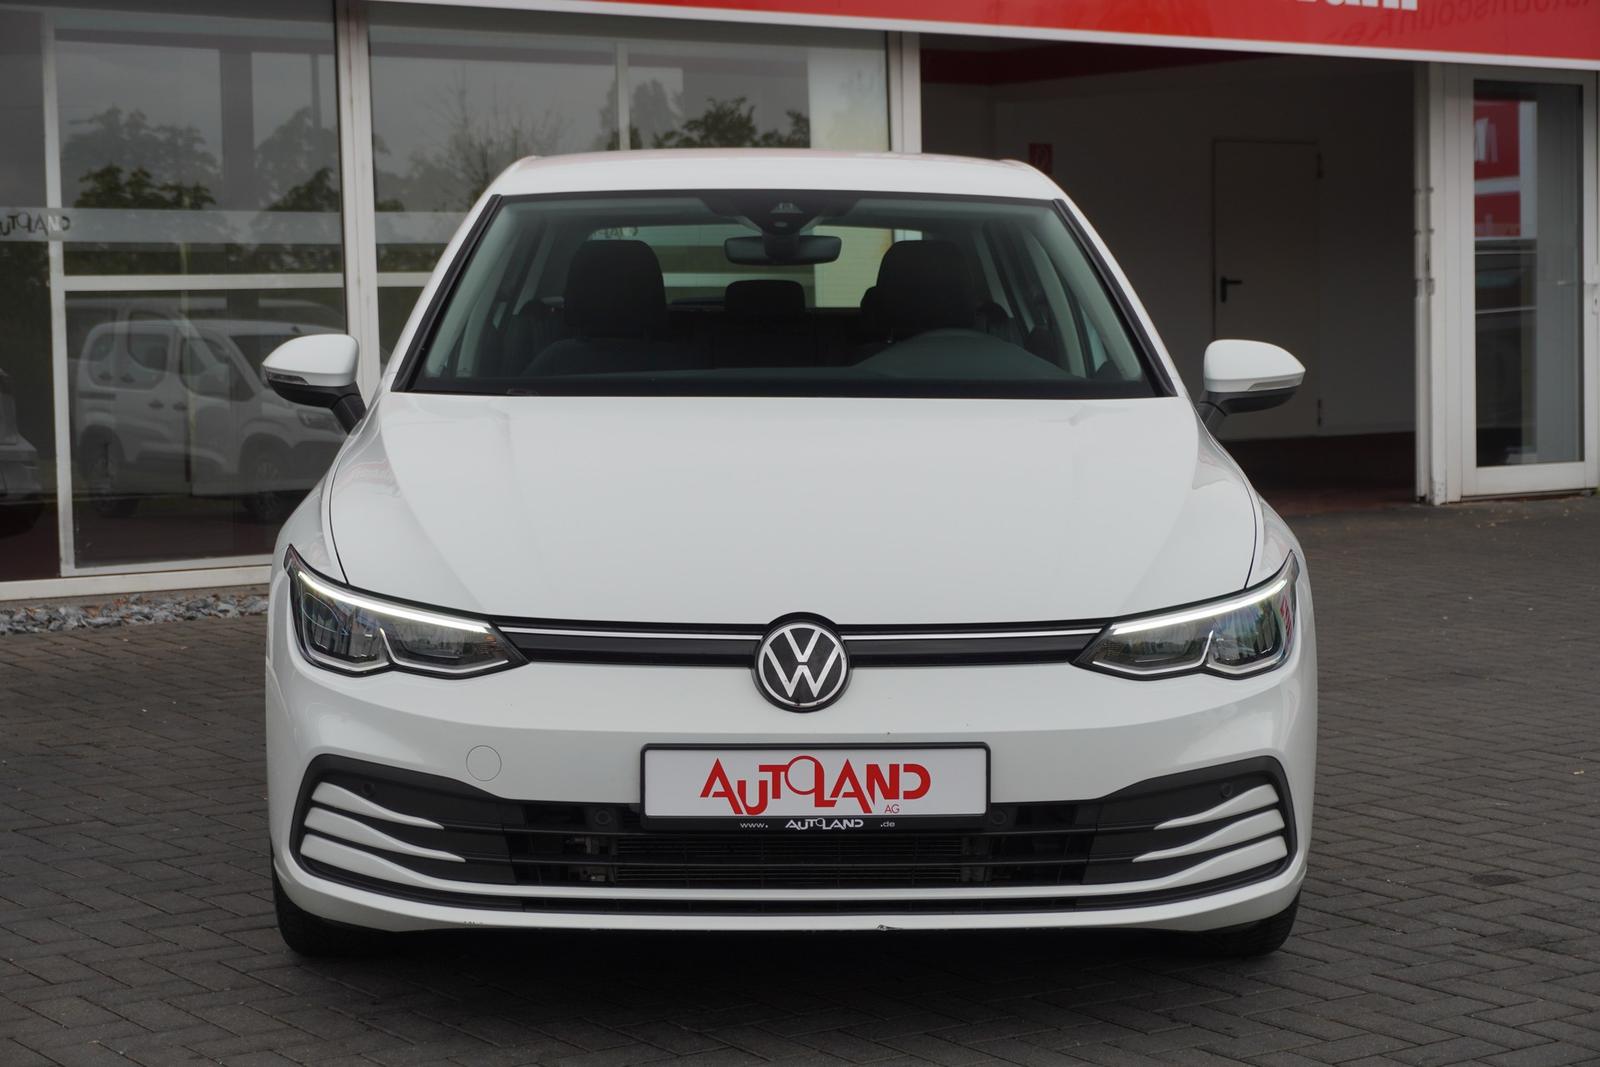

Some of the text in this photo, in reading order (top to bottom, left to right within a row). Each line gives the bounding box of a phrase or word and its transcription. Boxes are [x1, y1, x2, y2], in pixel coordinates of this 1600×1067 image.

[0, 211, 71, 237] UTOLAND
[763, 627, 842, 699] VW
[700, 755, 932, 816] AUTOLAND
[884, 804, 900, 814] AG
[739, 817, 896, 831] www. AUTOLAND .de
